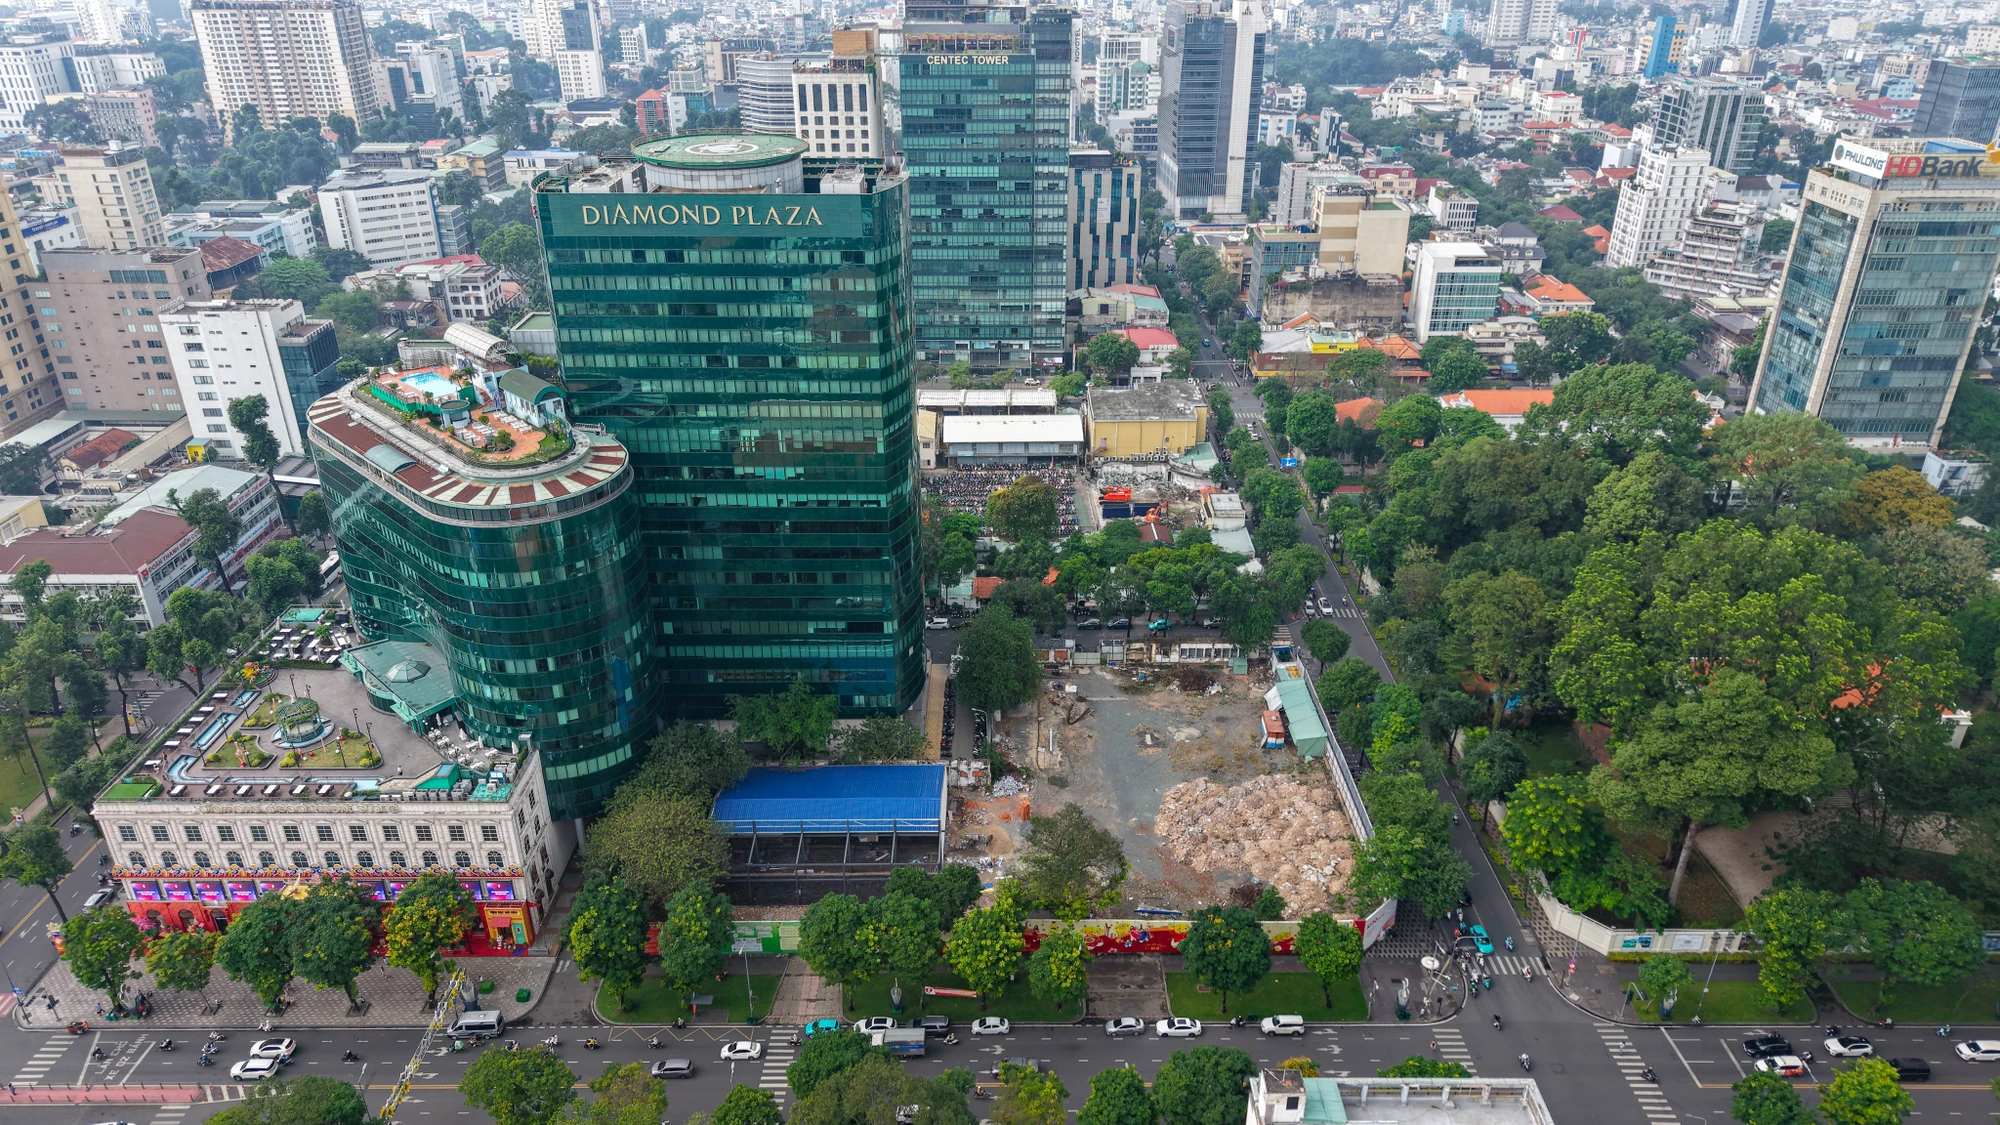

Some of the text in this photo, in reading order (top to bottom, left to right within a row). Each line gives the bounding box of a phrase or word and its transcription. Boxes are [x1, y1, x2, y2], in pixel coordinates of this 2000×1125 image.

[926, 55, 1009, 65] CENTEC TOWER
[1844, 150, 1883, 171] PHULONG
[1884, 155, 1984, 177] HDBank
[582, 202, 823, 226] DIAMOND PLAZA
[104, 1069, 120, 1080] XE
[126, 1033, 149, 1054] BÁNH
